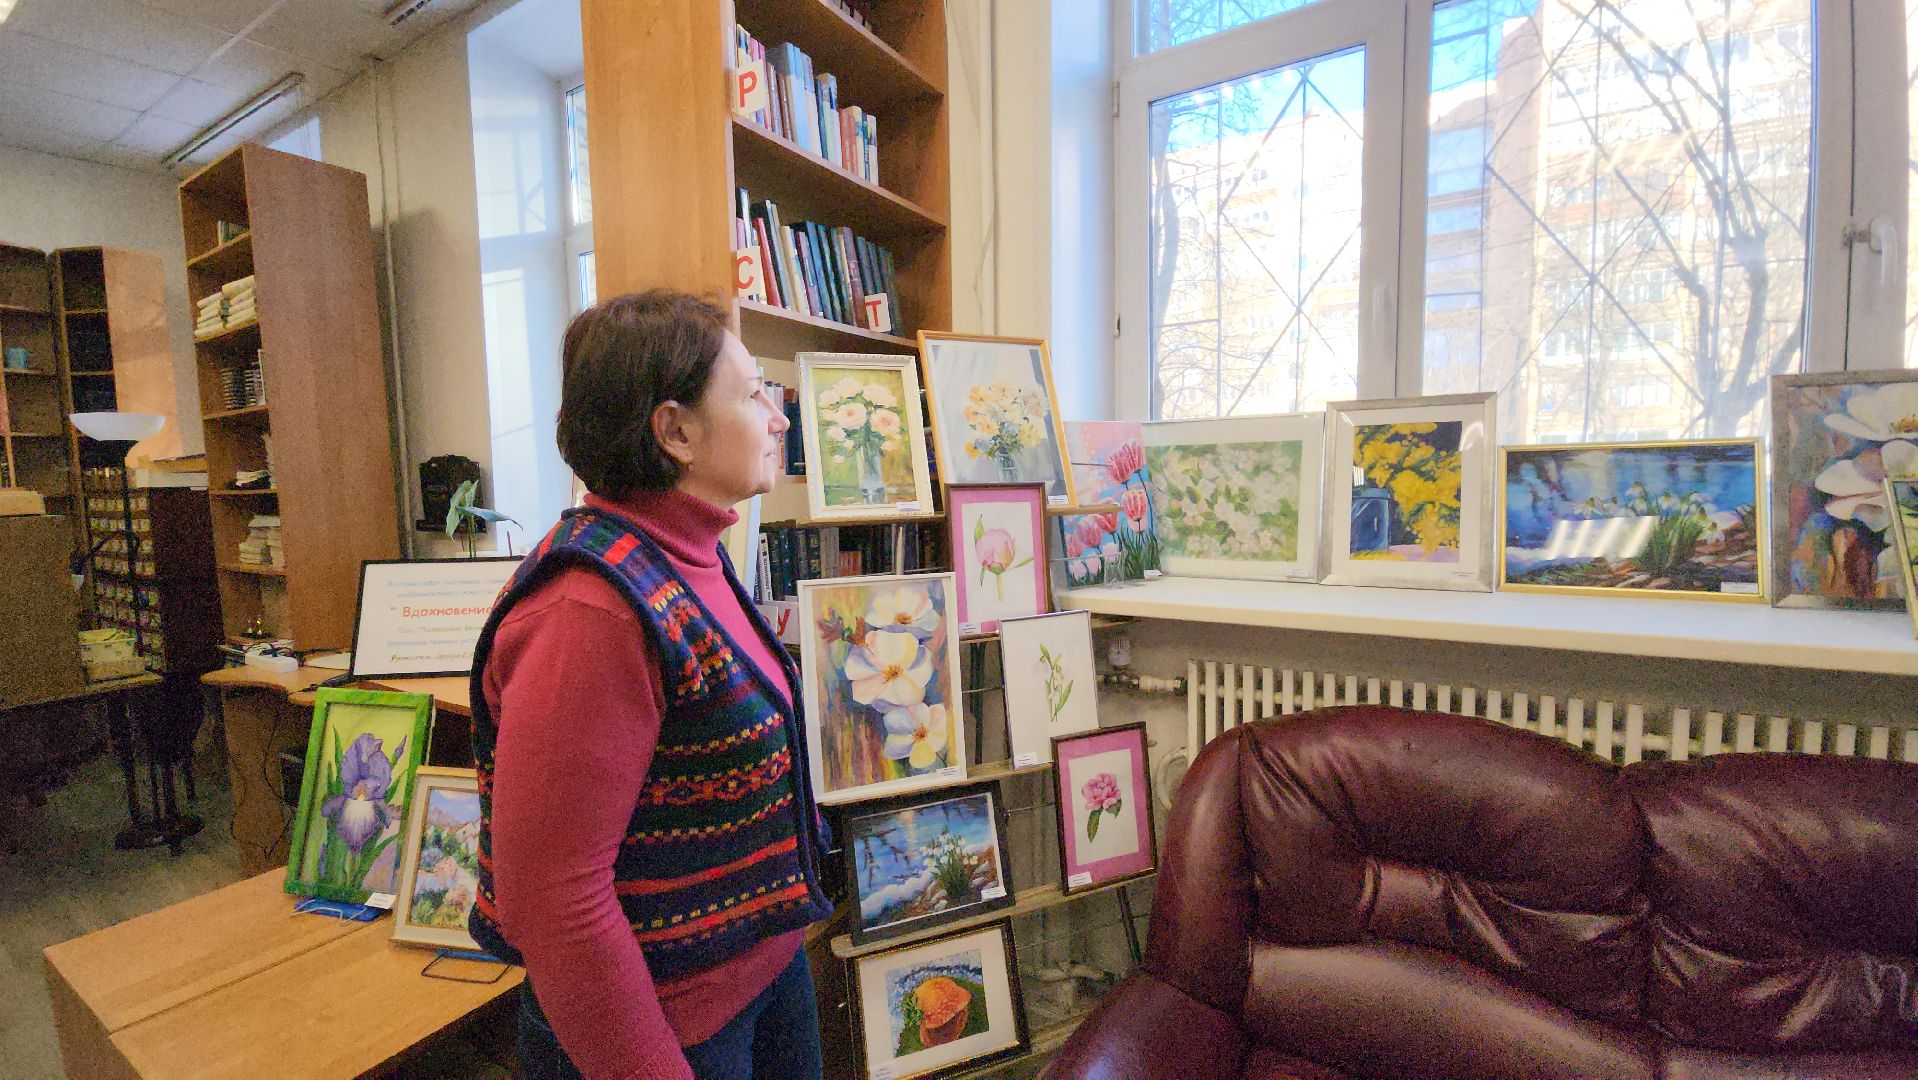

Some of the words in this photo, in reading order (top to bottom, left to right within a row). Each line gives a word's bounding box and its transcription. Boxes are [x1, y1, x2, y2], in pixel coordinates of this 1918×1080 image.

[738, 70, 758, 109] Р
[736, 255, 754, 290] С
[865, 299, 882, 328] Т
